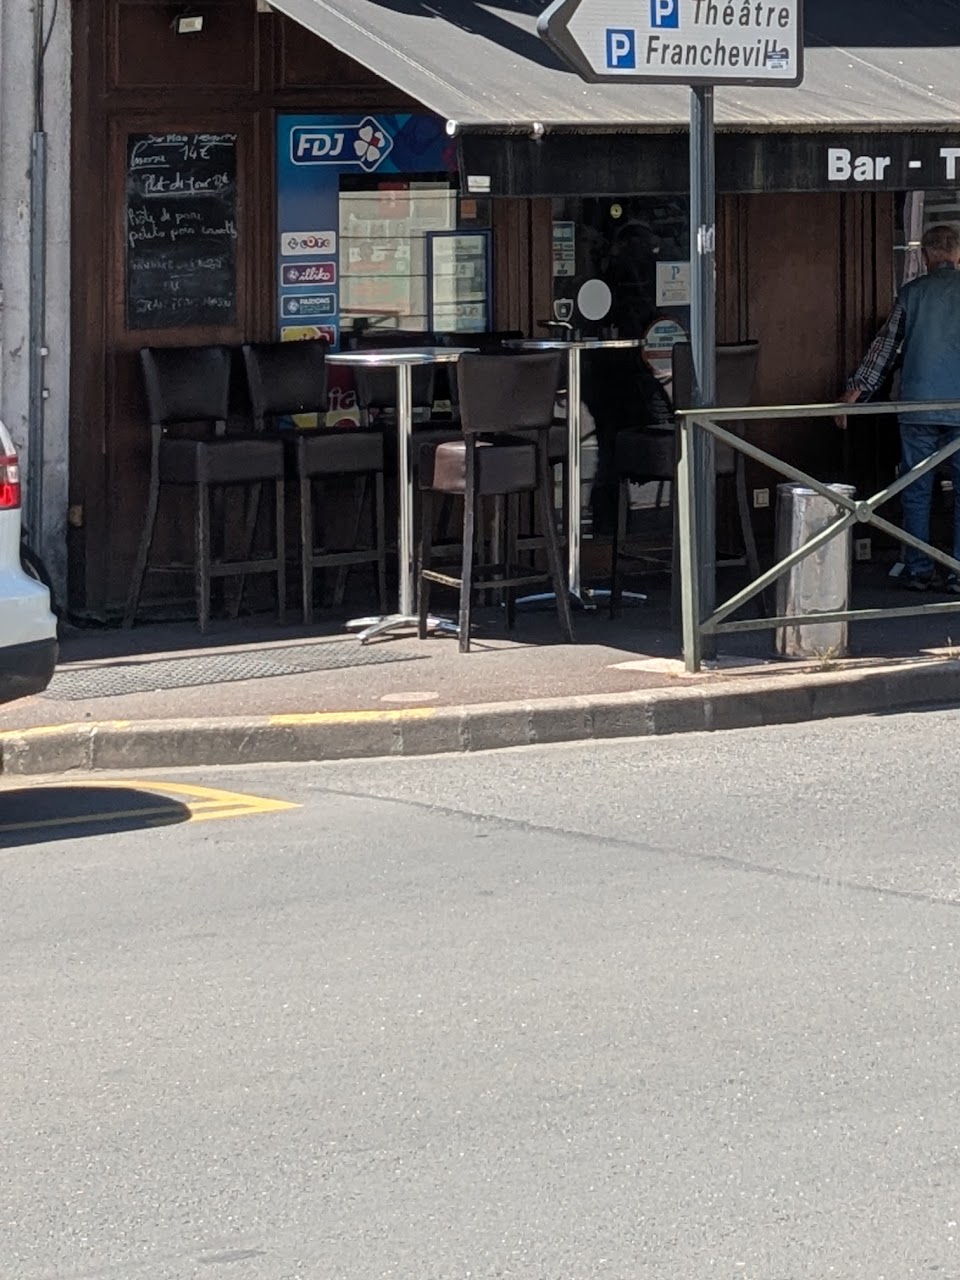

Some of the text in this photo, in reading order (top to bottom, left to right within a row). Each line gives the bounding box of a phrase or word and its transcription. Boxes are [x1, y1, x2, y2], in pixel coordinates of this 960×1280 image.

[610, 33, 630, 66] P
[297, 133, 344, 156] FDJ
[828, 148, 891, 181] Bar
[909, 160, 921, 168] -
